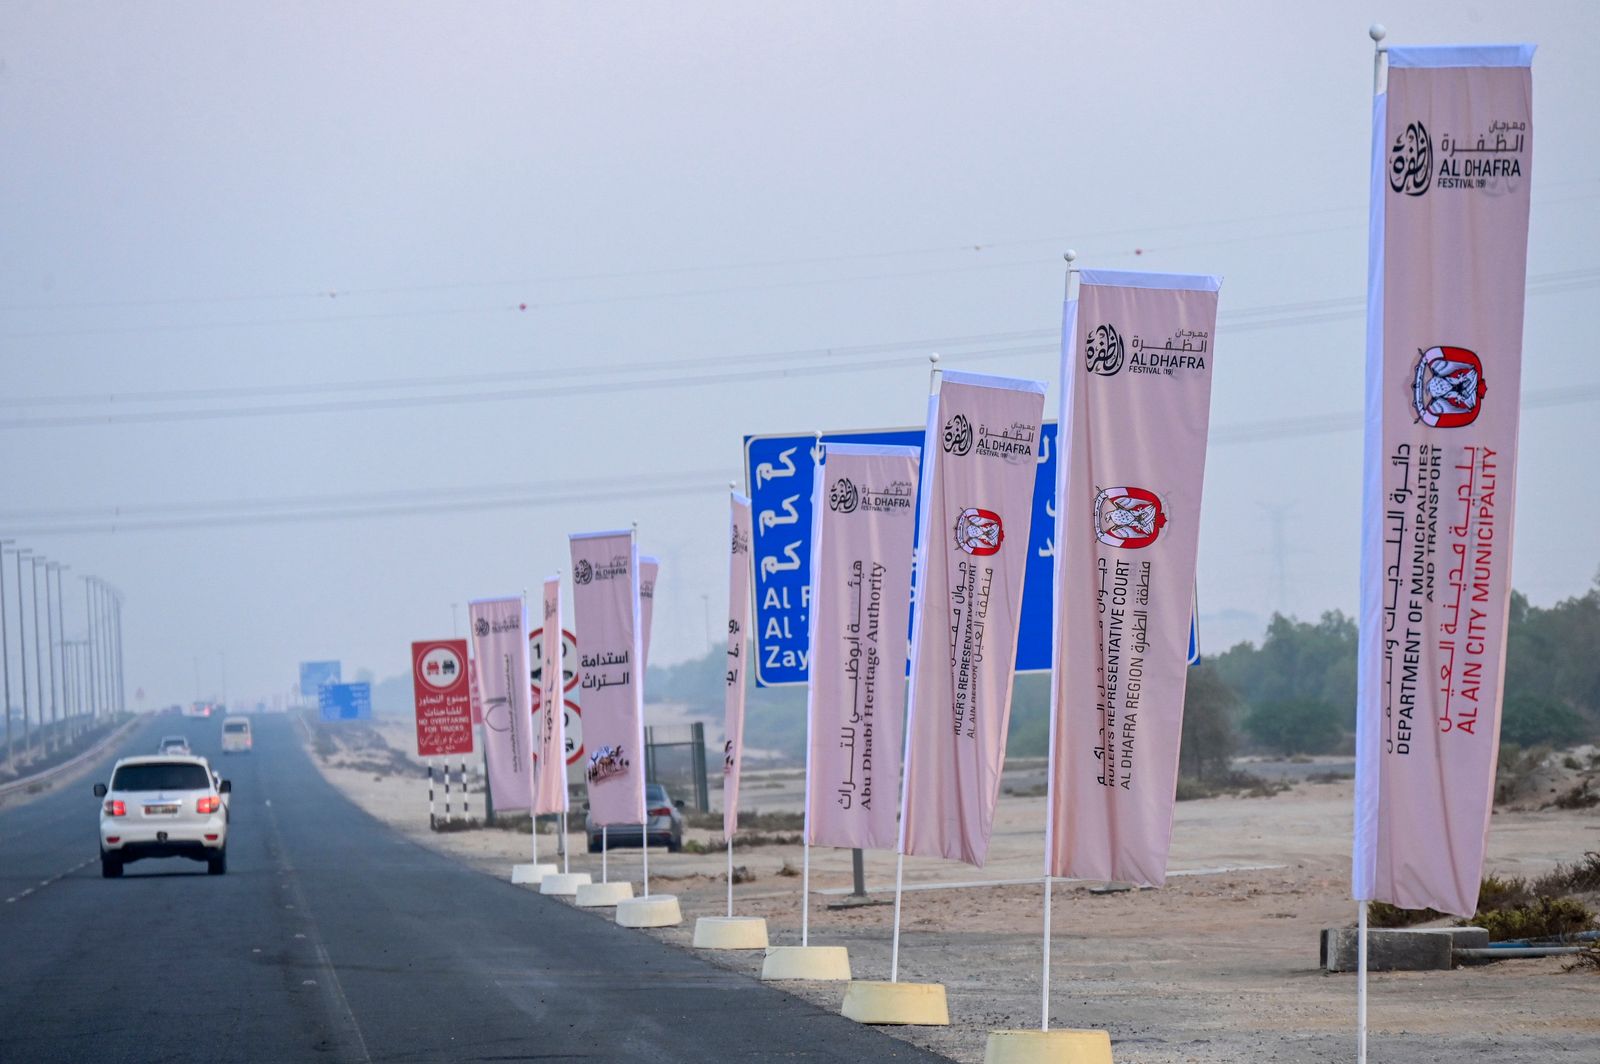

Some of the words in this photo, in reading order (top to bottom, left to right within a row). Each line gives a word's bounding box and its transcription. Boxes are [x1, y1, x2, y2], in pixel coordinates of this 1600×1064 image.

[1441, 133, 1524, 157] الظفرة
[1488, 119, 1526, 133] مهرجان
[1437, 178, 1474, 188] FESTIVAL
[1439, 159, 1460, 177] AL
[1465, 159, 1521, 177] DHAFRA
[1132, 335, 1208, 353] الظفرة
[1174, 328, 1208, 339] مهرجان
[1128, 365, 1161, 375] FESTIVAL
[1130, 352, 1147, 366] AL
[1150, 353, 1205, 370] DHAFRA
[975, 448, 999, 458] FESTIVAL
[977, 438, 989, 450] AL
[992, 440, 1031, 456] DHAFRA
[979, 424, 1034, 442] الظفرة
[756, 446, 798, 491] كم
[1390, 443, 1413, 504] دائرة
[861, 496, 872, 505] AL
[875, 497, 910, 508] DHAFRA
[1427, 444, 1442, 557] TRANSPORT
[1448, 446, 1479, 538] بلدية
[758, 493, 800, 538] كم
[1411, 444, 1428, 596] MUNICIPALITIES
[1472, 447, 1497, 602] MUNICIPALITY
[761, 539, 802, 583] كم
[951, 561, 968, 604] ديوان
[1112, 559, 1130, 606] COURT
[1384, 510, 1408, 632] البلديات
[1426, 562, 1435, 603] AND
[763, 586, 791, 610] Al
[847, 560, 865, 633] هيئة
[866, 561, 886, 643] Authority
[975, 567, 993, 619] منطقة
[1097, 557, 1108, 613] ديوان
[1136, 561, 1151, 606] منطقة
[1440, 544, 1467, 635] مدينة
[764, 616, 792, 640] Al
[958, 599, 973, 691] REPRESENTATIVE
[967, 564, 977, 598] COURT
[1131, 610, 1151, 654] الظفرة
[1408, 599, 1423, 623] OF
[1466, 608, 1487, 655] CITY
[581, 650, 629, 668] استدامة
[764, 645, 809, 671] Zay
[973, 622, 985, 663] العين
[581, 672, 629, 691] التراث
[864, 647, 880, 717] Heritage
[1107, 608, 1124, 727] REPRESENTATIVE
[1126, 657, 1143, 709] REGION
[1437, 640, 1456, 733] العين
[1461, 662, 1482, 702] AIN
[1397, 628, 1421, 755] DEPARTMENT
[966, 725, 975, 739] AL
[1121, 713, 1137, 769] DHAFRA
[1457, 707, 1478, 735] AL
[838, 727, 856, 810] للتراث
[862, 722, 873, 771] Dhabi
[1107, 731, 1115, 787] RULER'S
[861, 777, 871, 811] Abu
[1120, 772, 1131, 790] AL
